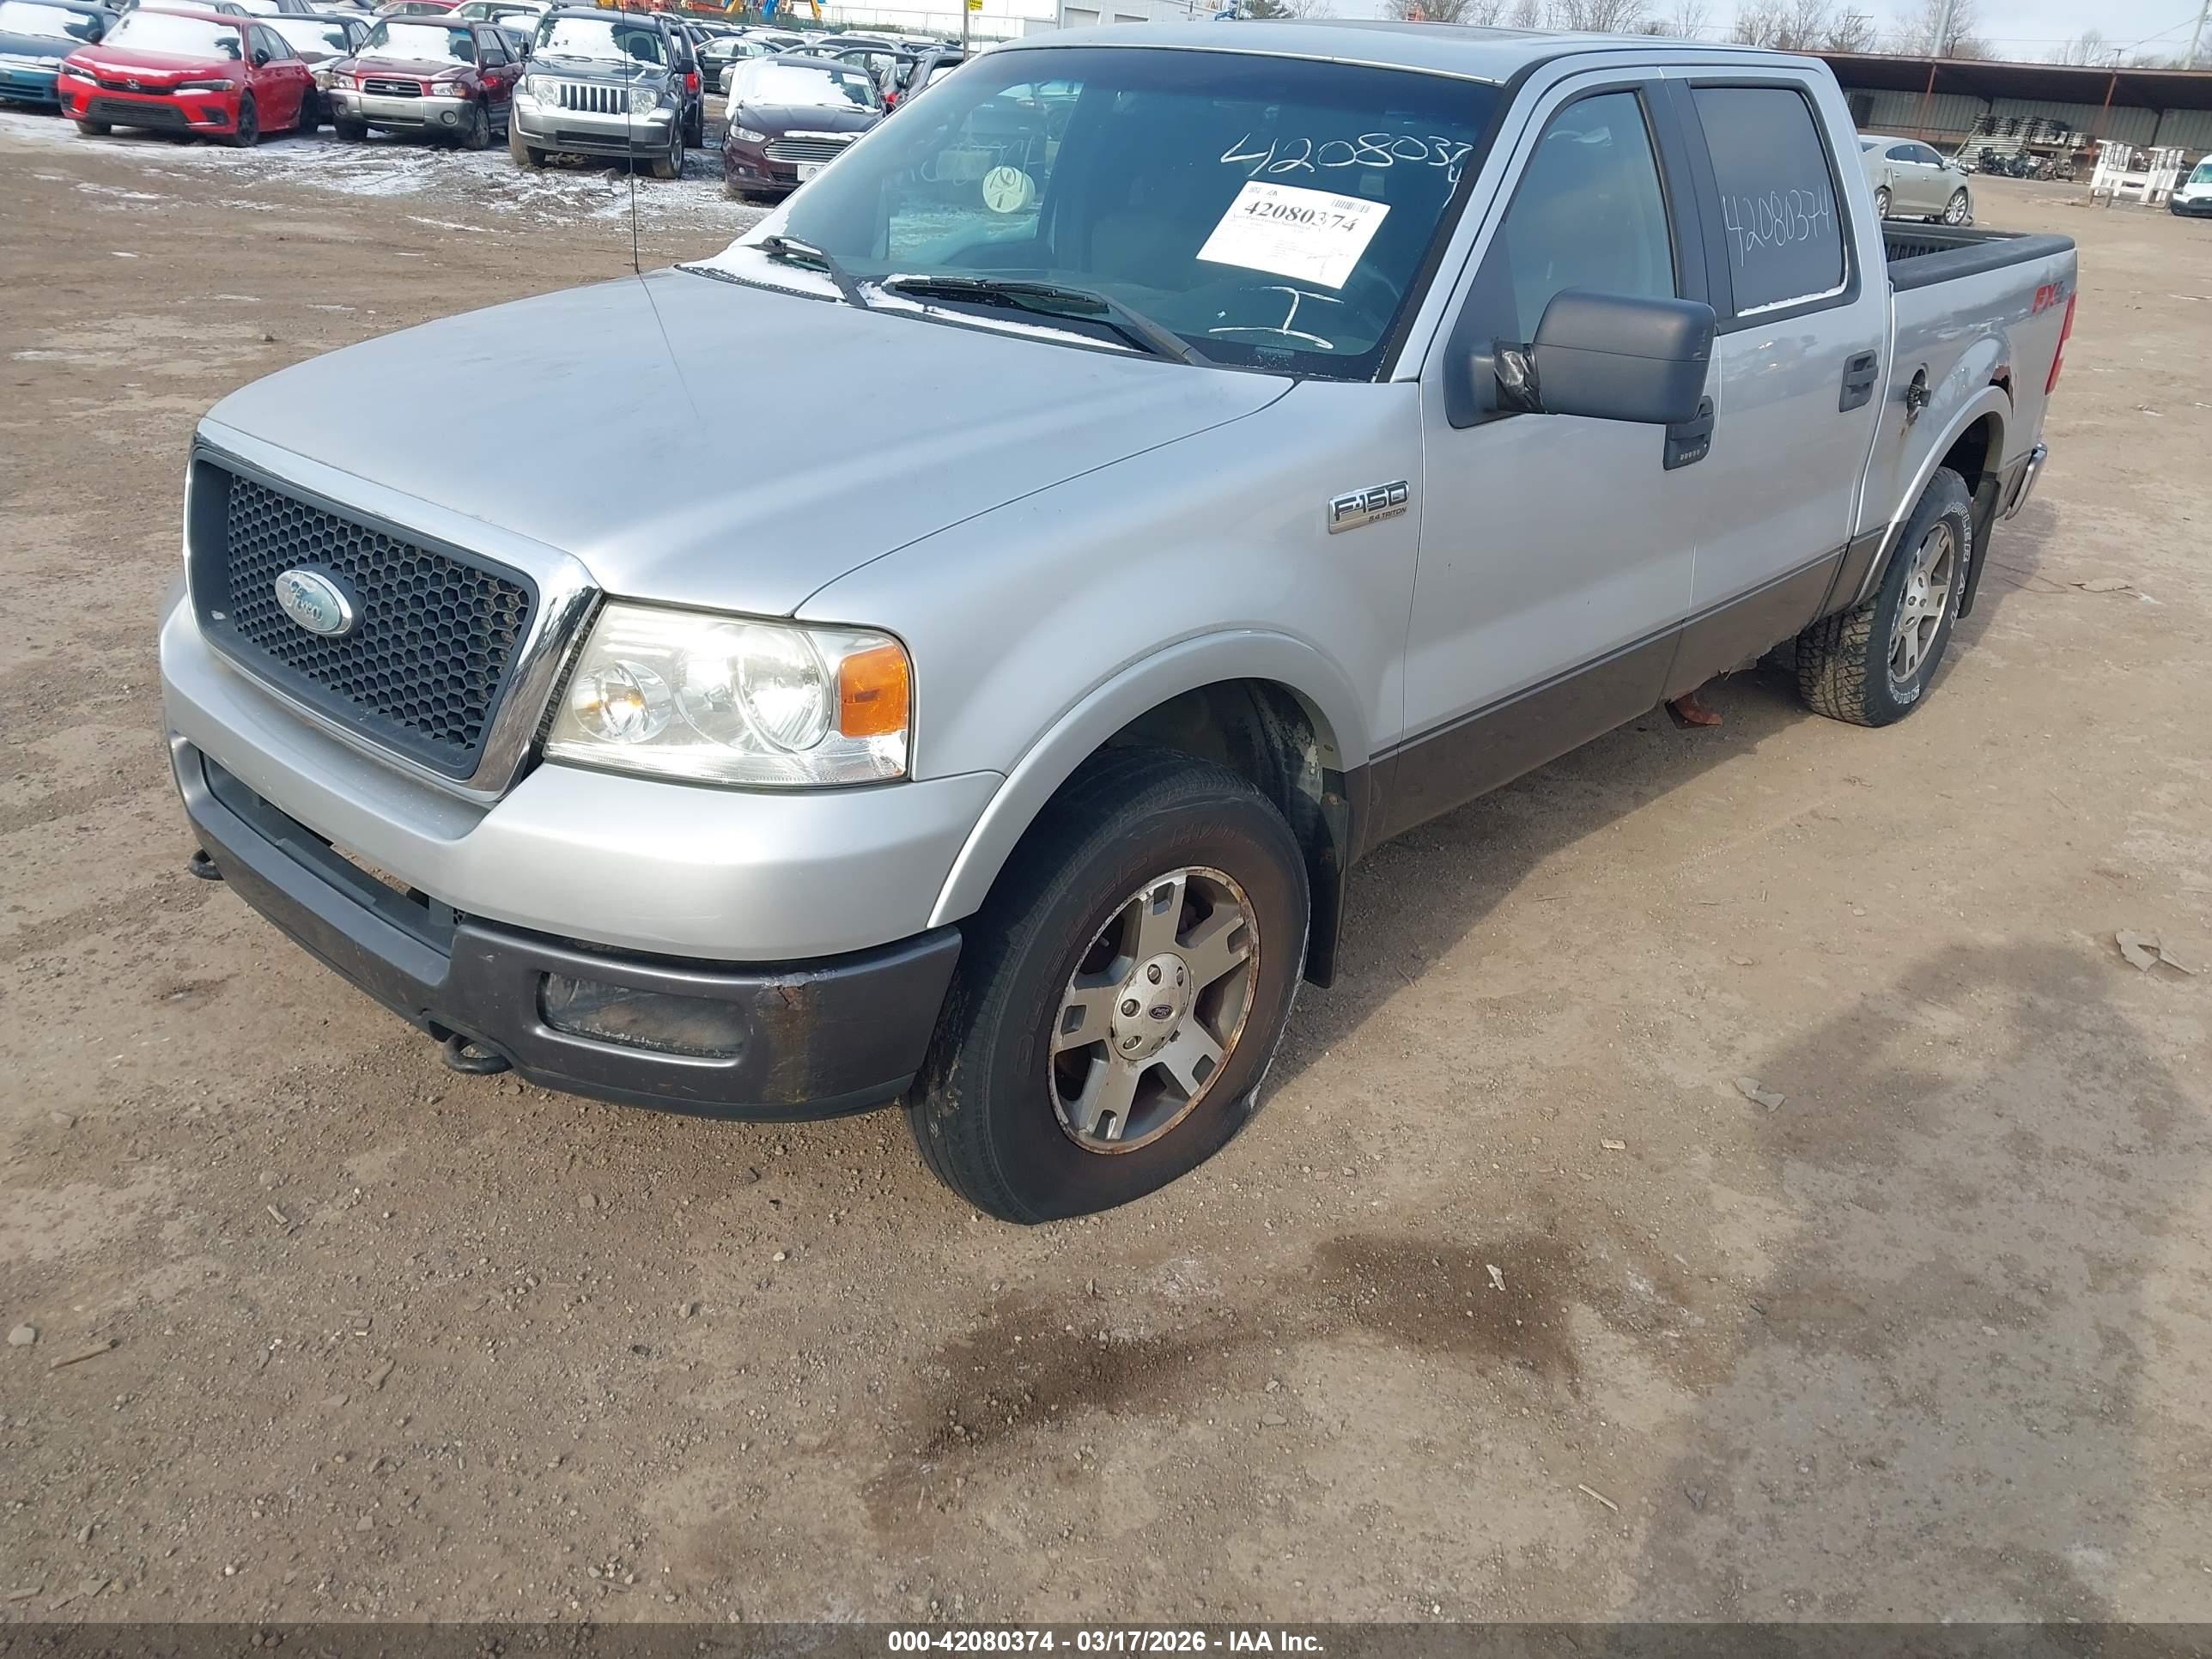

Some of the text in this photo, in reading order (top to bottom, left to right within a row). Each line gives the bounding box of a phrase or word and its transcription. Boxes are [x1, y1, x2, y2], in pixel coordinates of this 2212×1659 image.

[1244, 200, 1360, 232] 42080374
[1723, 185, 1830, 268] 42080374
[1334, 483, 1408, 522] F-150
[1382, 507, 1407, 520] TRITON
[286, 580, 324, 622] Ford
